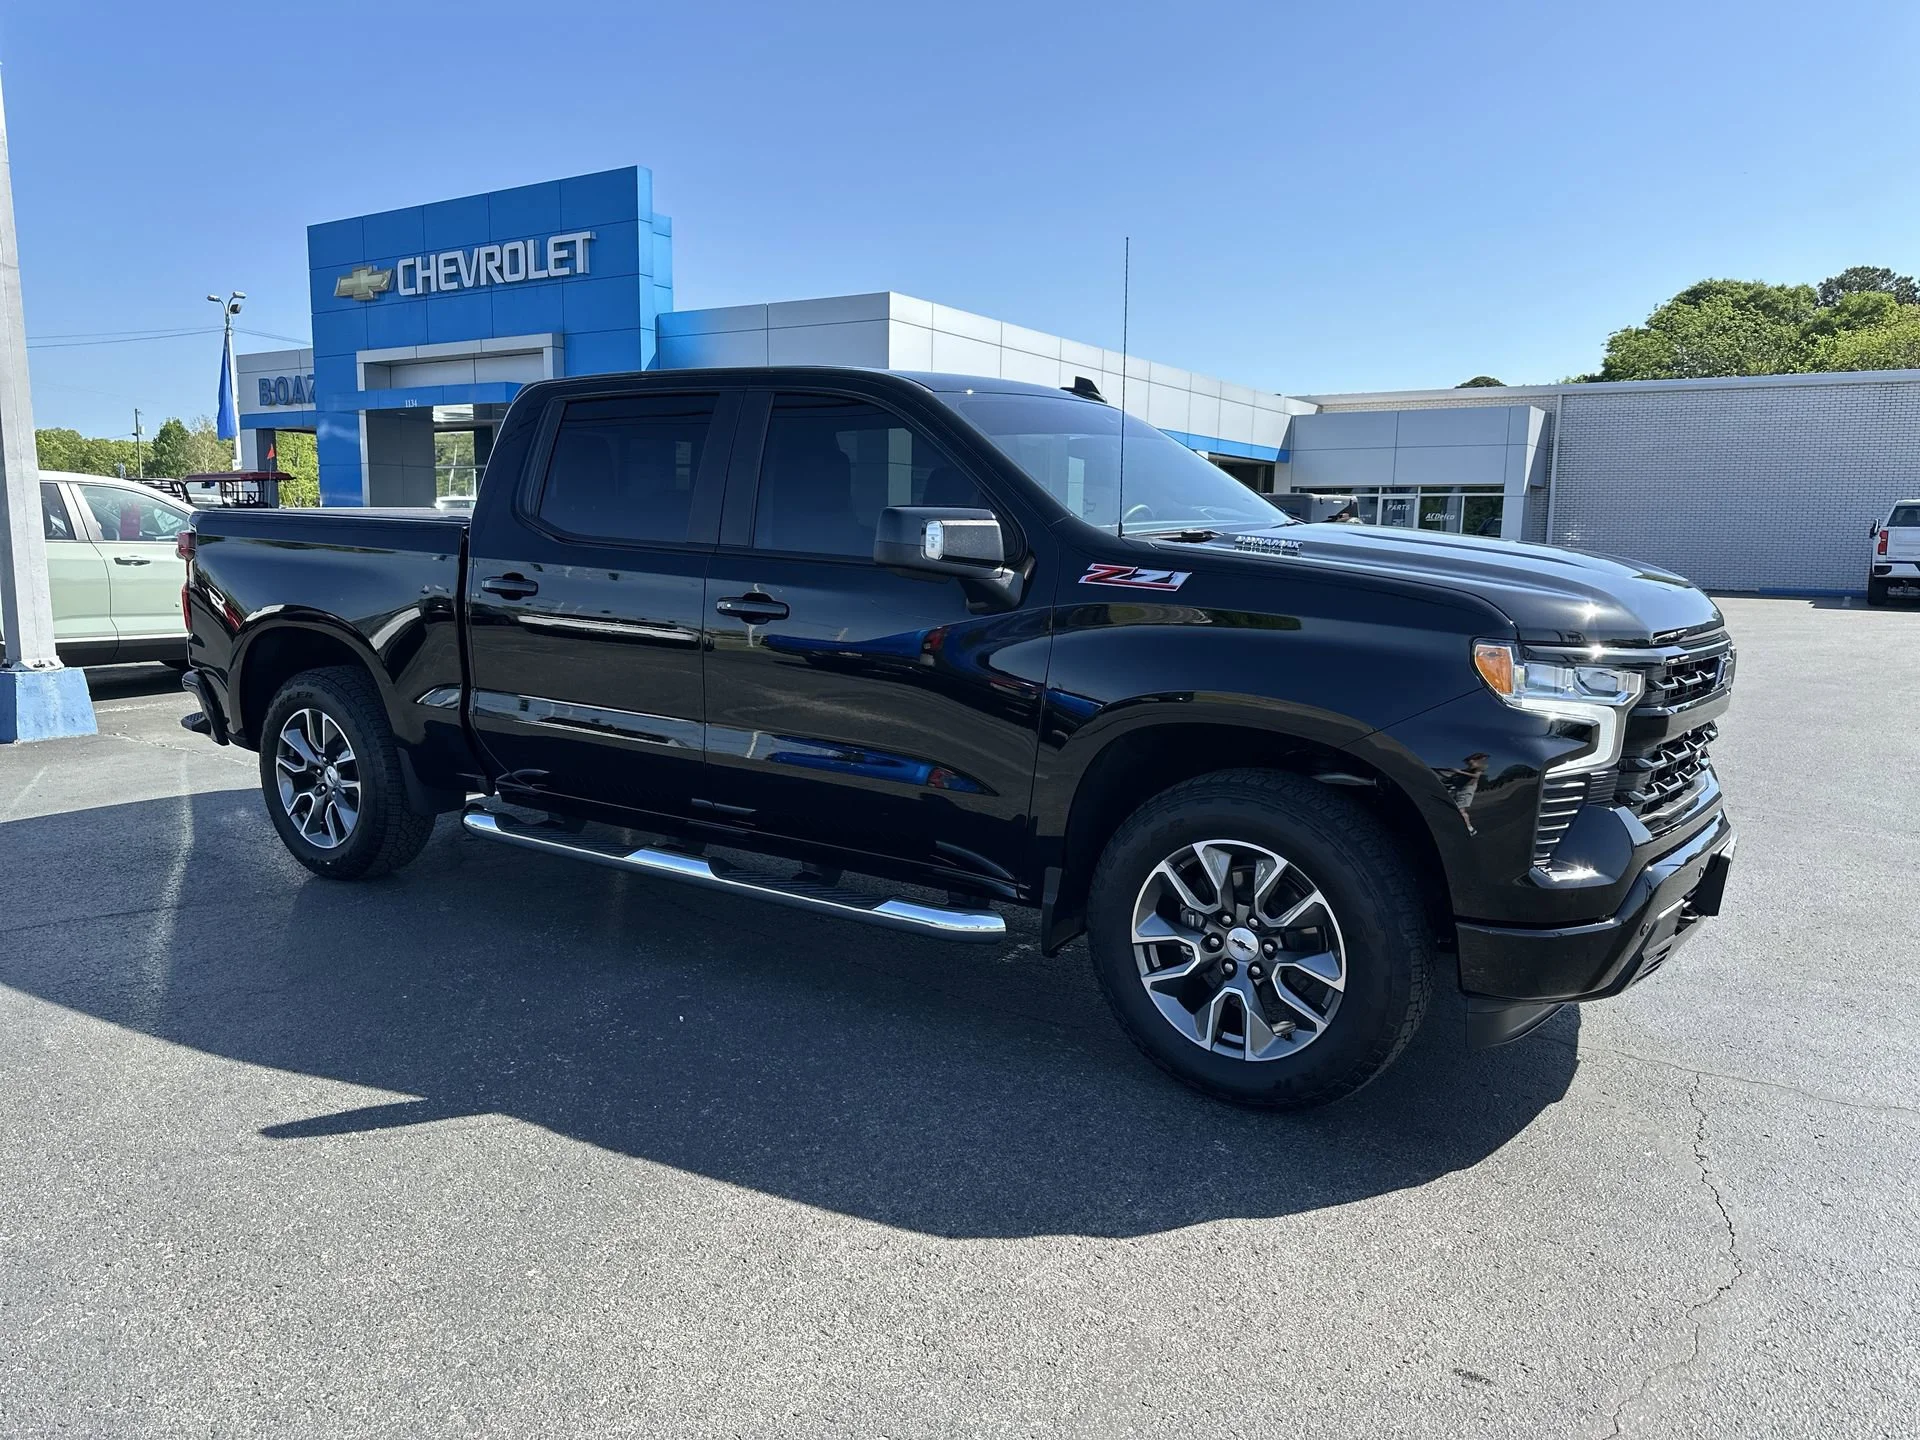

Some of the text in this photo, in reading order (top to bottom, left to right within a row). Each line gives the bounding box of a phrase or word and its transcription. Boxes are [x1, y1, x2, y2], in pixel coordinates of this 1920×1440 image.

[397, 231, 596, 297] CHEVROLET
[405, 399, 418, 408] 1134
[1386, 504, 1411, 512] PARTS
[1425, 512, 1456, 521] ACDelco
[1078, 562, 1193, 592] Z71
